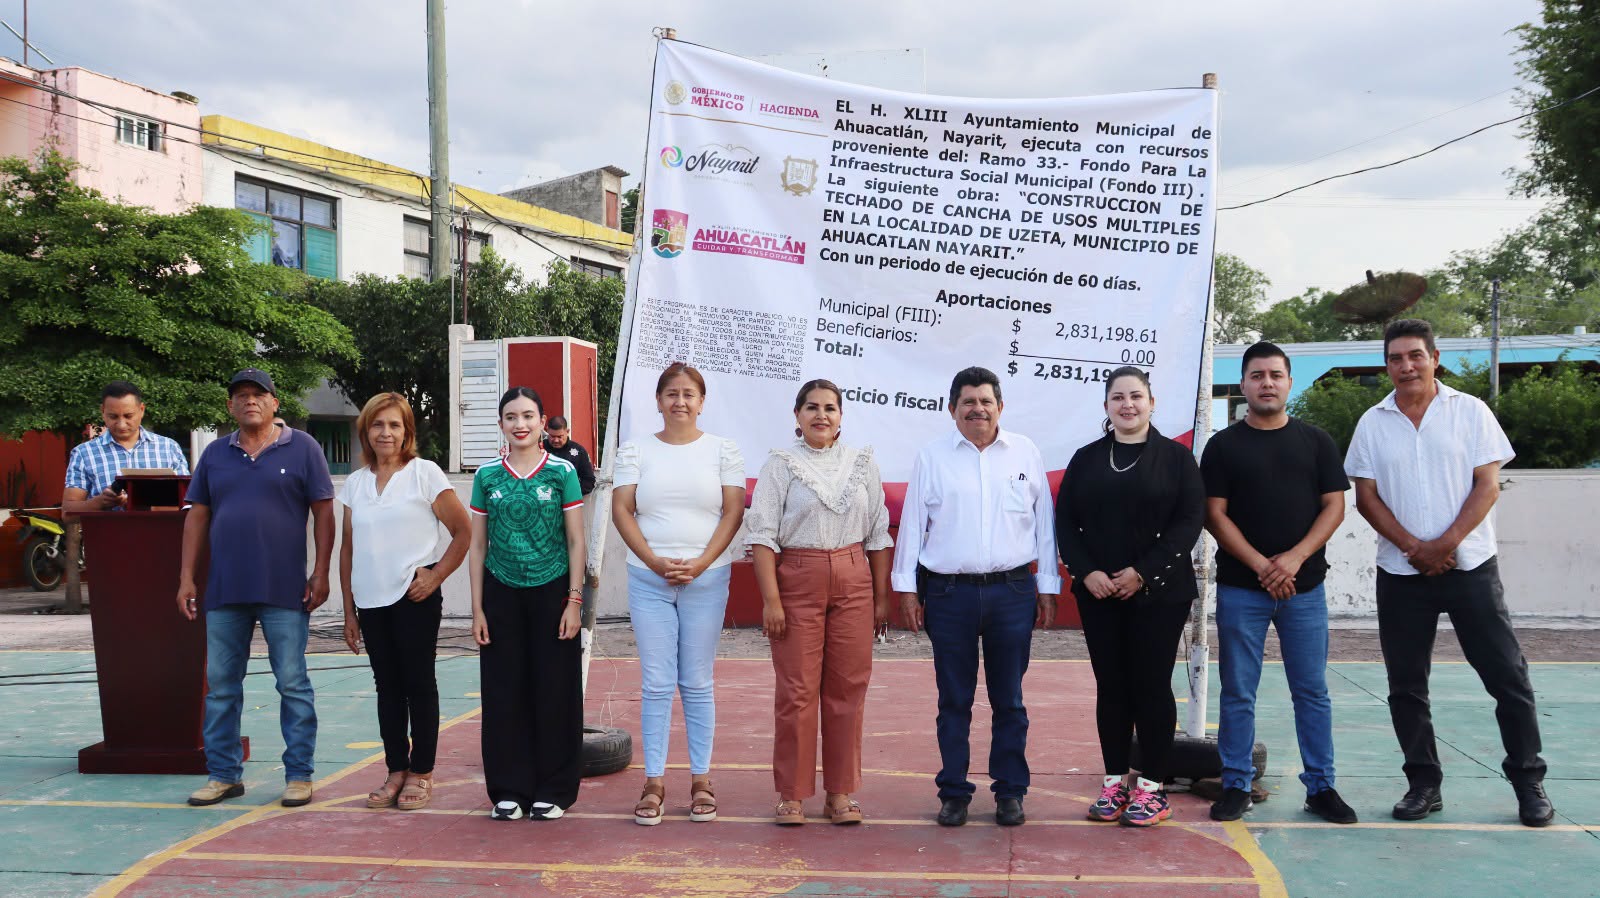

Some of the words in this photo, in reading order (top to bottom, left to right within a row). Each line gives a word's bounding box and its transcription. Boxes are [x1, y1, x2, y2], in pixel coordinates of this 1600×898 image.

[691, 94, 743, 111] MÉXICO
[692, 87, 731, 98] GOBIERNO
[760, 103, 819, 118] HACIENDA
[836, 100, 854, 113] EL
[871, 104, 886, 117] H.
[904, 107, 947, 122] XLIII
[964, 113, 1079, 132] Ayuntamiento
[1096, 122, 1174, 138] Municipal
[1192, 126, 1211, 140] de
[834, 119, 928, 142] Ahuacatlán,
[943, 130, 1007, 149] Nayarit,
[1021, 137, 1081, 152] ejecuta
[1096, 143, 1124, 154] con
[1140, 144, 1208, 158] recursos
[686, 150, 760, 174] Nayarit
[832, 139, 928, 159] proveniente
[939, 149, 968, 162] del:
[980, 152, 1025, 167] Ramo
[1037, 157, 1068, 169] 33.-
[1080, 159, 1130, 172] Fondo
[1142, 161, 1176, 176] Para
[1188, 165, 1206, 178] La
[830, 155, 953, 179] Infraestructura
[960, 169, 1007, 184] Social
[1015, 173, 1092, 191] Municipal
[1100, 177, 1156, 195] (Fondo
[1163, 183, 1193, 199] III)
[828, 173, 846, 186] La
[864, 178, 938, 196] siguiente
[957, 188, 999, 202] obra:
[1020, 192, 1161, 214] “CONSTRUCCION
[1181, 204, 1203, 216] DE
[826, 190, 902, 211] TECHADO
[912, 201, 934, 214] DE
[943, 204, 1011, 221] CANCHA
[1021, 211, 1043, 223] DE
[1053, 213, 1097, 228] USOS
[1107, 217, 1200, 236] MULTIPLES
[694, 229, 805, 254] AHUACATLÁN
[733, 227, 777, 238] AYUNTAMIENTO
[821, 229, 930, 251] AHUACATLAN
[823, 209, 844, 223] EN
[851, 212, 870, 226] LA
[878, 216, 972, 237] LOCALIDAD
[980, 226, 1002, 239] DE
[1009, 229, 1066, 248] UZETA,
[1074, 234, 1169, 254] MUNICIPIO
[1177, 242, 1198, 255] DE
[697, 243, 726, 252] CUIDAR
[737, 248, 799, 262] TRANSFORMAR
[820, 248, 849, 262] Con
[855, 254, 873, 265] un
[879, 256, 940, 272] periodo
[946, 261, 965, 274] de
[970, 264, 1047, 283] ejecución
[1053, 272, 1073, 285] de
[1078, 274, 1098, 288] 60
[1103, 276, 1141, 291] días.
[664, 301, 696, 309] PROGRAMA
[722, 308, 752, 316] CARACTER
[936, 290, 1052, 314] Aportaciones
[820, 298, 889, 320] Municipal
[896, 306, 942, 327] (FIII):
[655, 326, 684, 334] PROHIBIDO
[737, 336, 769, 344] PROGRAMA
[699, 319, 731, 327] RECURSOS
[738, 323, 772, 331] PROVIENEN
[779, 322, 807, 330] POLITICO
[817, 318, 917, 342] Beneficiarios:
[1012, 318, 1022, 334] $
[1056, 323, 1157, 343] 2,831,198.61
[749, 331, 804, 342] CONTRIBUYENTES
[695, 351, 728, 360] RECURSOS
[814, 338, 863, 357] Total:
[1010, 339, 1019, 355] $
[1121, 349, 1155, 364] 0.00
[693, 357, 732, 366] DENUNCIADO
[748, 364, 786, 373] SANCIONADO
[699, 365, 731, 373] APLICABLE
[765, 373, 800, 381] AUTORIDAD
[1008, 360, 1018, 376] $
[895, 392, 944, 411] fiscal
